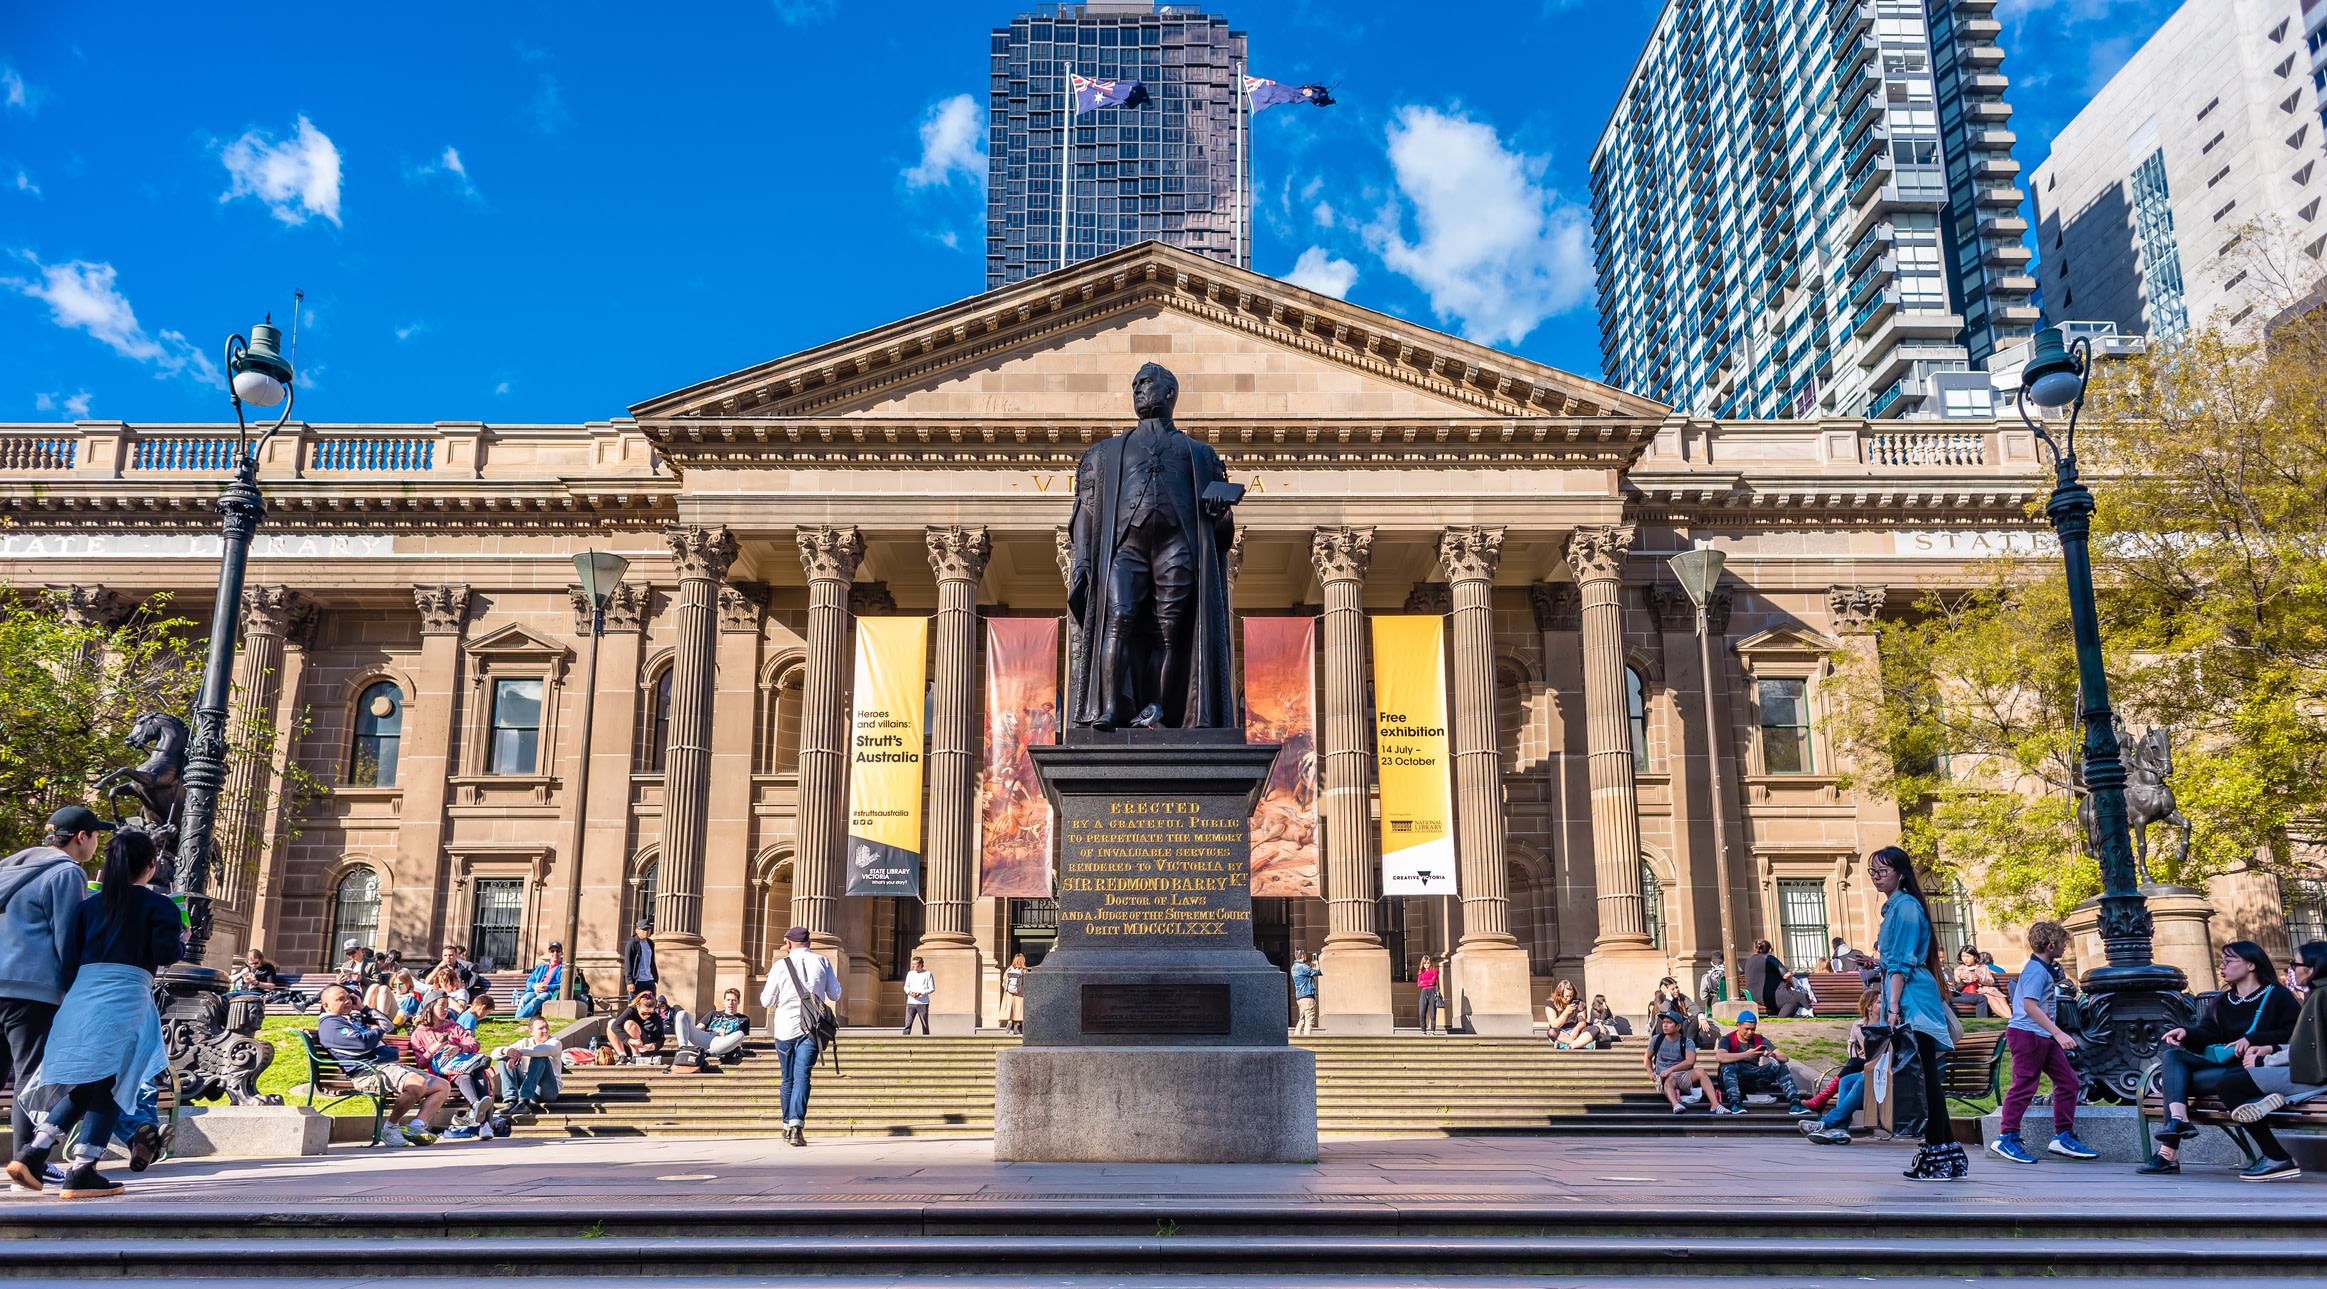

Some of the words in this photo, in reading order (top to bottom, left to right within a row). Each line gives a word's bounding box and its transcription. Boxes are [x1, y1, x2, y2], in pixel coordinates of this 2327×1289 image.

[190, 537, 382, 553] LIRARY
[1915, 534, 2049, 550] STATE
[857, 710, 889, 718] Heroes
[1380, 712, 1407, 722] Free
[857, 720, 876, 728] and
[877, 720, 911, 728] villains:
[1380, 726, 1444, 737] exhibition
[856, 735, 903, 747] Strutt's
[1382, 745, 1392, 753] 14
[1395, 745, 1413, 755] July
[856, 751, 919, 763] Australia
[1381, 757, 1393, 765] 23
[1395, 757, 1436, 766] October
[1110, 802, 1200, 814] ERECTED
[1071, 819, 1089, 829] BY
[1094, 819, 1104, 829] A
[1109, 819, 1184, 829] GRATEFUL
[1068, 833, 1083, 843] TO
[1086, 833, 1164, 843] PERPETUATE
[1166, 833, 1191, 843] THE
[1194, 833, 1243, 843] MEMORY
[1080, 847, 1094, 857] OF
[1097, 847, 1172, 857] INVALUABLE
[1176, 847, 1231, 857] SERVICES
[1068, 862, 1132, 871] RENDERED
[1136, 862, 1151, 871] TO
[1228, 862, 1243, 871] BY
[1062, 877, 1093, 891] SIR
[1094, 877, 1170, 891] REDMOND
[1171, 877, 1228, 891] BARRY
[1154, 896, 1168, 905] OF
[1060, 911, 1084, 921] AND
[1084, 911, 1094, 921] A
[1129, 911, 1141, 920] OF
[1141, 911, 1164, 920] THE
